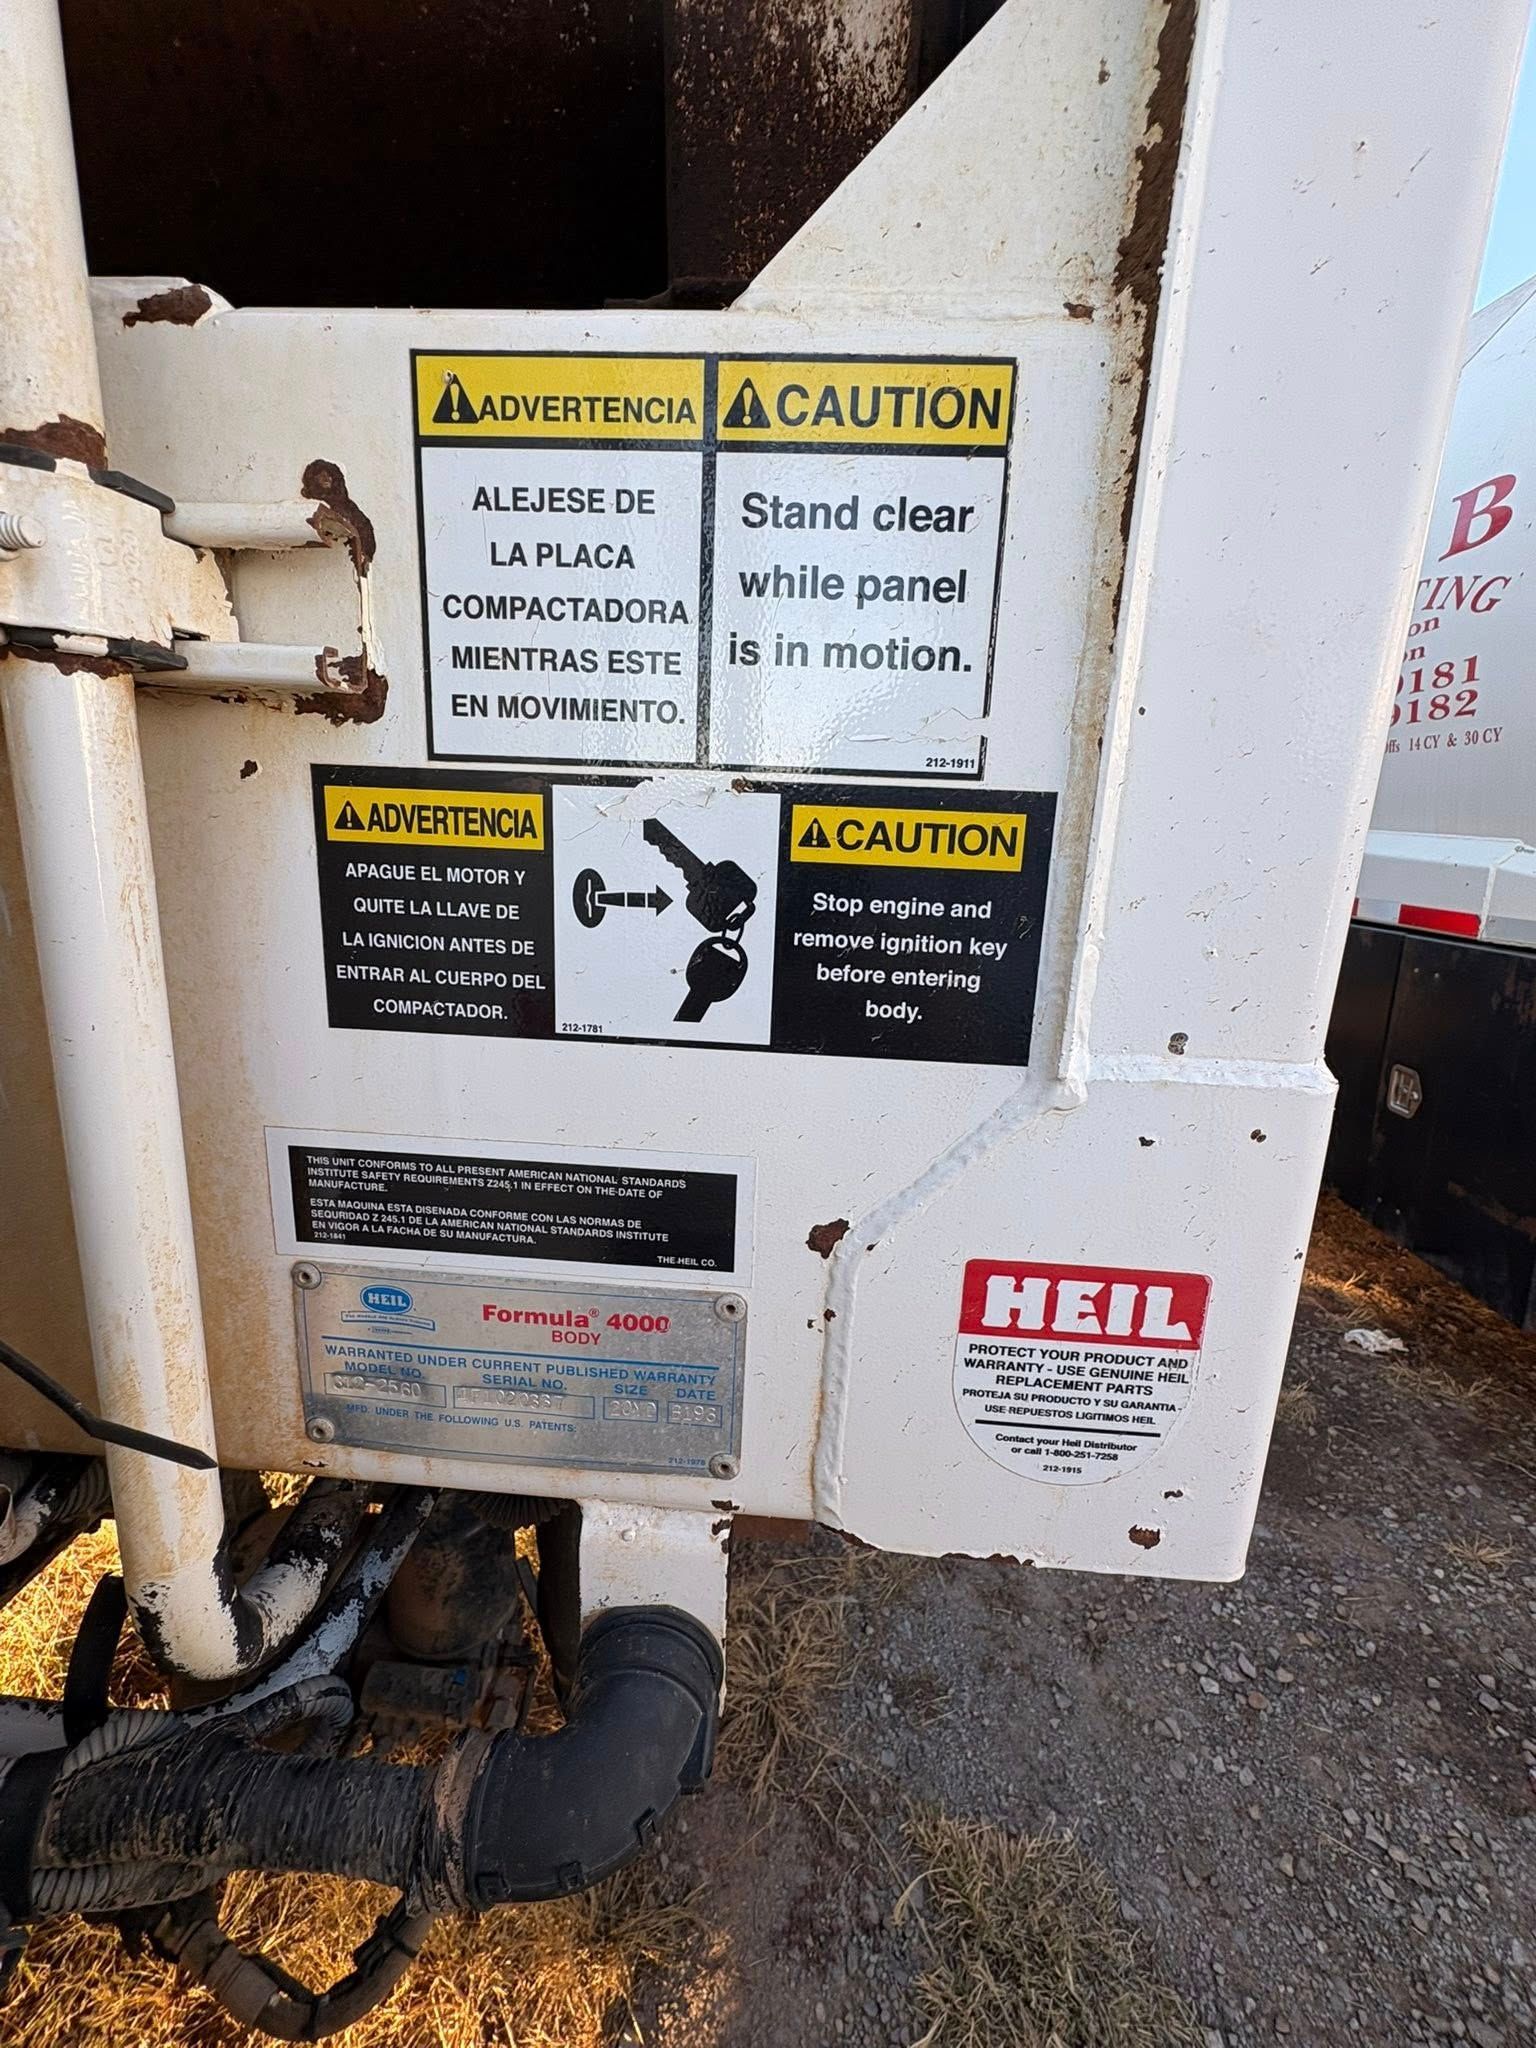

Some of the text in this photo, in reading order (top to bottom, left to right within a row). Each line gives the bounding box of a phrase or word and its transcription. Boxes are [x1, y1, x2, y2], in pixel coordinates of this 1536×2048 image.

[479, 396, 696, 425] ADVERTENCIA
[776, 384, 1001, 430] CAUTION
[471, 486, 655, 516] ALEJESE DE
[741, 492, 974, 533] Stand clear
[1438, 474, 1516, 562] B
[490, 541, 635, 570] LA PLACA
[738, 565, 966, 611] while panel
[442, 593, 688, 625] COMPACTADORA
[451, 645, 681, 676] MIENTRAS ESTE
[729, 630, 971, 674] is in motion.
[451, 694, 684, 725] EN MOVIMIENTO.
[926, 756, 975, 769] 212-1911
[367, 803, 537, 839] ADVERTENCIA
[836, 819, 1018, 857] CAUTION
[345, 862, 525, 885] APAGUE EL MOTOR Y
[353, 897, 519, 920] QUITE LA LLAVE DE
[812, 892, 991, 919] Stop engine and
[342, 931, 534, 956] LA IGNICION ANTES DE
[793, 931, 1007, 960] remove ignition key
[336, 964, 545, 989] ENTRAR AL CUERPO DEL
[816, 963, 980, 993] before entering
[373, 998, 508, 1020] COMPACTADOR.
[865, 1000, 922, 1023] body.
[561, 1022, 603, 1033] 212-1781
[306, 1155, 686, 1189] THIS UNIT CONFORMS TO ALL PRESENT AMERICAN NATIONAL STANDARDS
[306, 1167, 360, 1179] INSTITUTE
[361, 1171, 400, 1182] SAFETY
[403, 1173, 485, 1188] REQUIREMENTS
[534, 1181, 574, 1193] EFFECT
[576, 1184, 592, 1195] ON
[594, 1185, 616, 1196] THE
[618, 1187, 646, 1198] DATE
[648, 1189, 664, 1199] OF
[308, 1178, 388, 1192] MANUFACTURE.
[309, 1198, 624, 1228] ESTA MAQUINA ESTA DISENADA CONFORME CON LAS NORMAS
[327, 1222, 359, 1232] VIGOR
[455, 1231, 536, 1245] MANUFACTURA.
[440, 1218, 494, 1231] AMERICAN
[496, 1222, 548, 1234] NATIONAL
[550, 1225, 613, 1239] STANDARDS
[615, 1229, 668, 1242] INSTITUTE
[656, 1255, 716, 1267] THE HEIL CO.
[367, 1292, 408, 1308] HEIL
[981, 1275, 1192, 1340] HEIL
[606, 1313, 672, 1333] 4000
[552, 1331, 601, 1345] BODY
[324, 1345, 716, 1385] WARRANTED UNDER CURRENT PUBLISHED WARRANTY
[968, 1344, 1188, 1369] PROTECT YOUR PRODUCT AND
[344, 1361, 426, 1379] MODEL NO.
[482, 1374, 568, 1390] SERIAL NO.
[963, 1358, 1189, 1384] WARRANTY USE GENUINE HEIL
[614, 1384, 648, 1395] SIZE
[676, 1388, 716, 1400] DATE
[995, 1376, 1153, 1395] REPLACEMENT PARTS
[962, 1388, 1176, 1412] PROTEJA SU PRODUCTO SU GARANTIA
[374, 1406, 408, 1417] UNDER
[414, 1409, 433, 1419] THE
[438, 1411, 501, 1425] FOLLOWING
[984, 1405, 1006, 1415] USE
[1007, 1406, 1073, 1419] REPUESTOS
[1131, 1414, 1155, 1424] HEIL
[994, 1434, 1137, 1451] Contact your Heil Distributor
[1010, 1446, 1022, 1455] or
[1023, 1446, 1042, 1456] call
[1043, 1465, 1082, 1474] 212-1915
